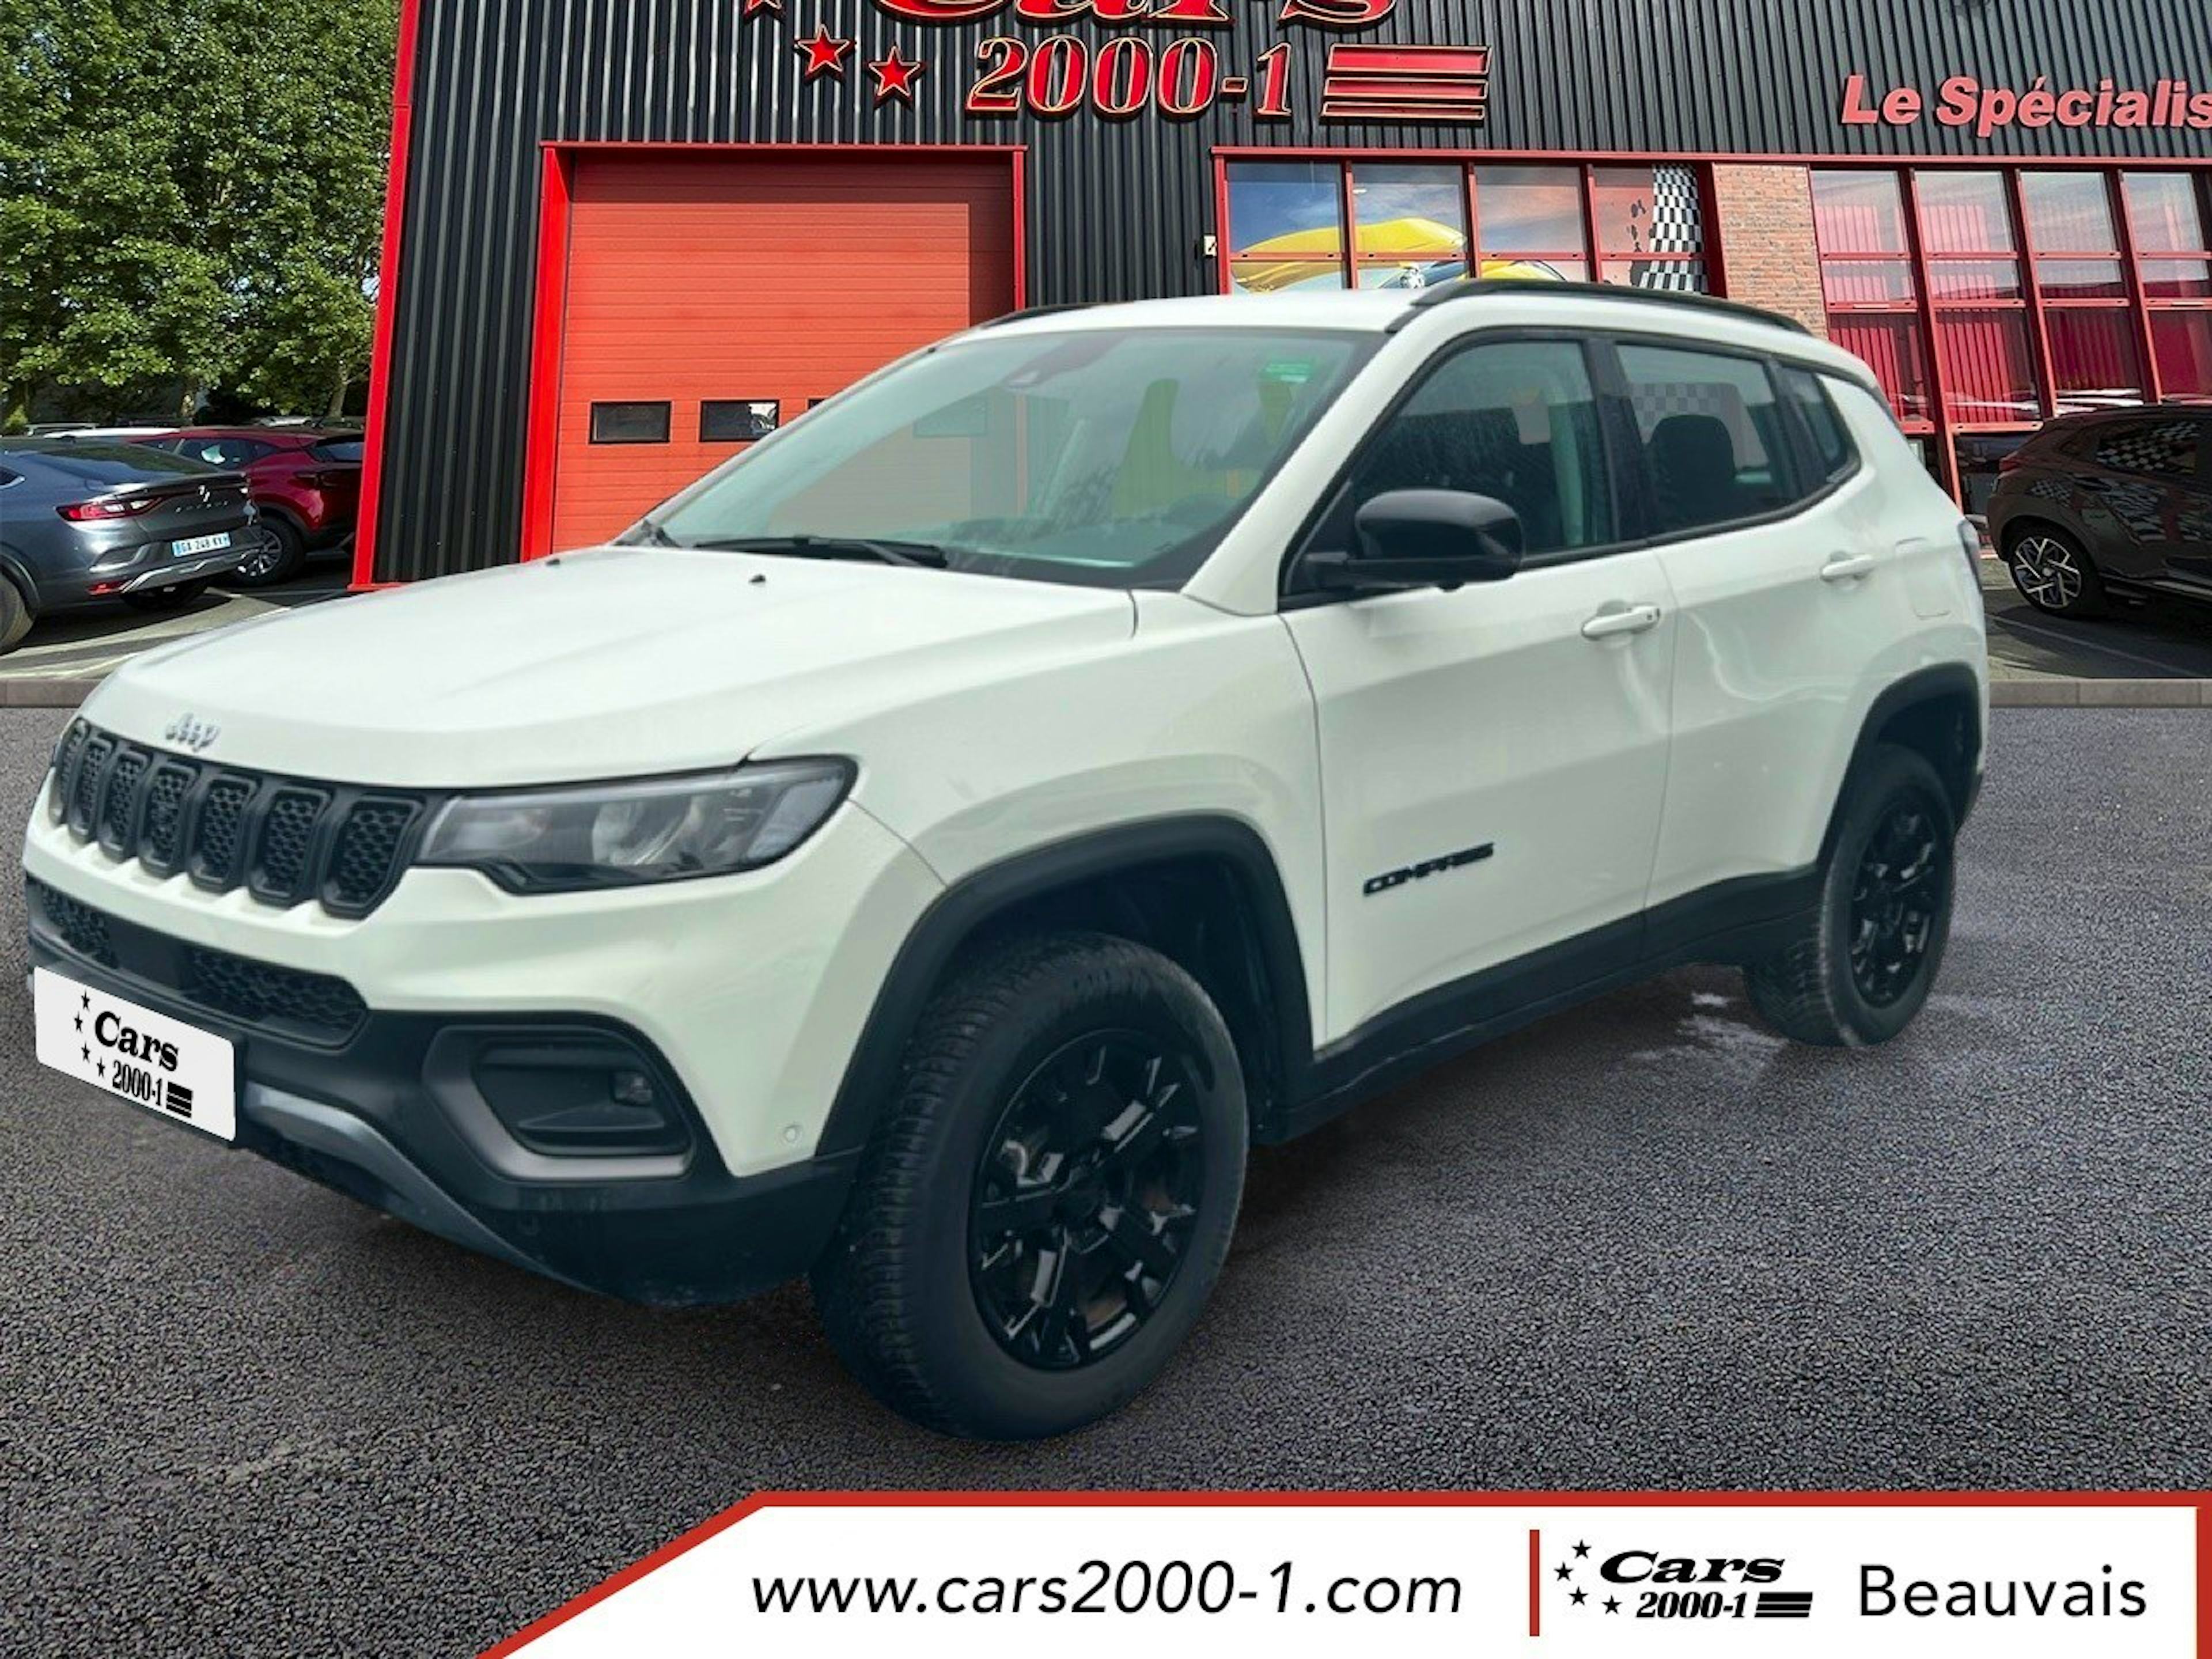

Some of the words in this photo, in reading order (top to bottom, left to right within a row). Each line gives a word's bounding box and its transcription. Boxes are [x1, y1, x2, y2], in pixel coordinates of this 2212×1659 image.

[966, 35, 1292, 116] 2000-1
[1842, 75, 1922, 126] Le
[94, 1011, 179, 1071] Cars
[112, 1059, 162, 1106] 2000-1
